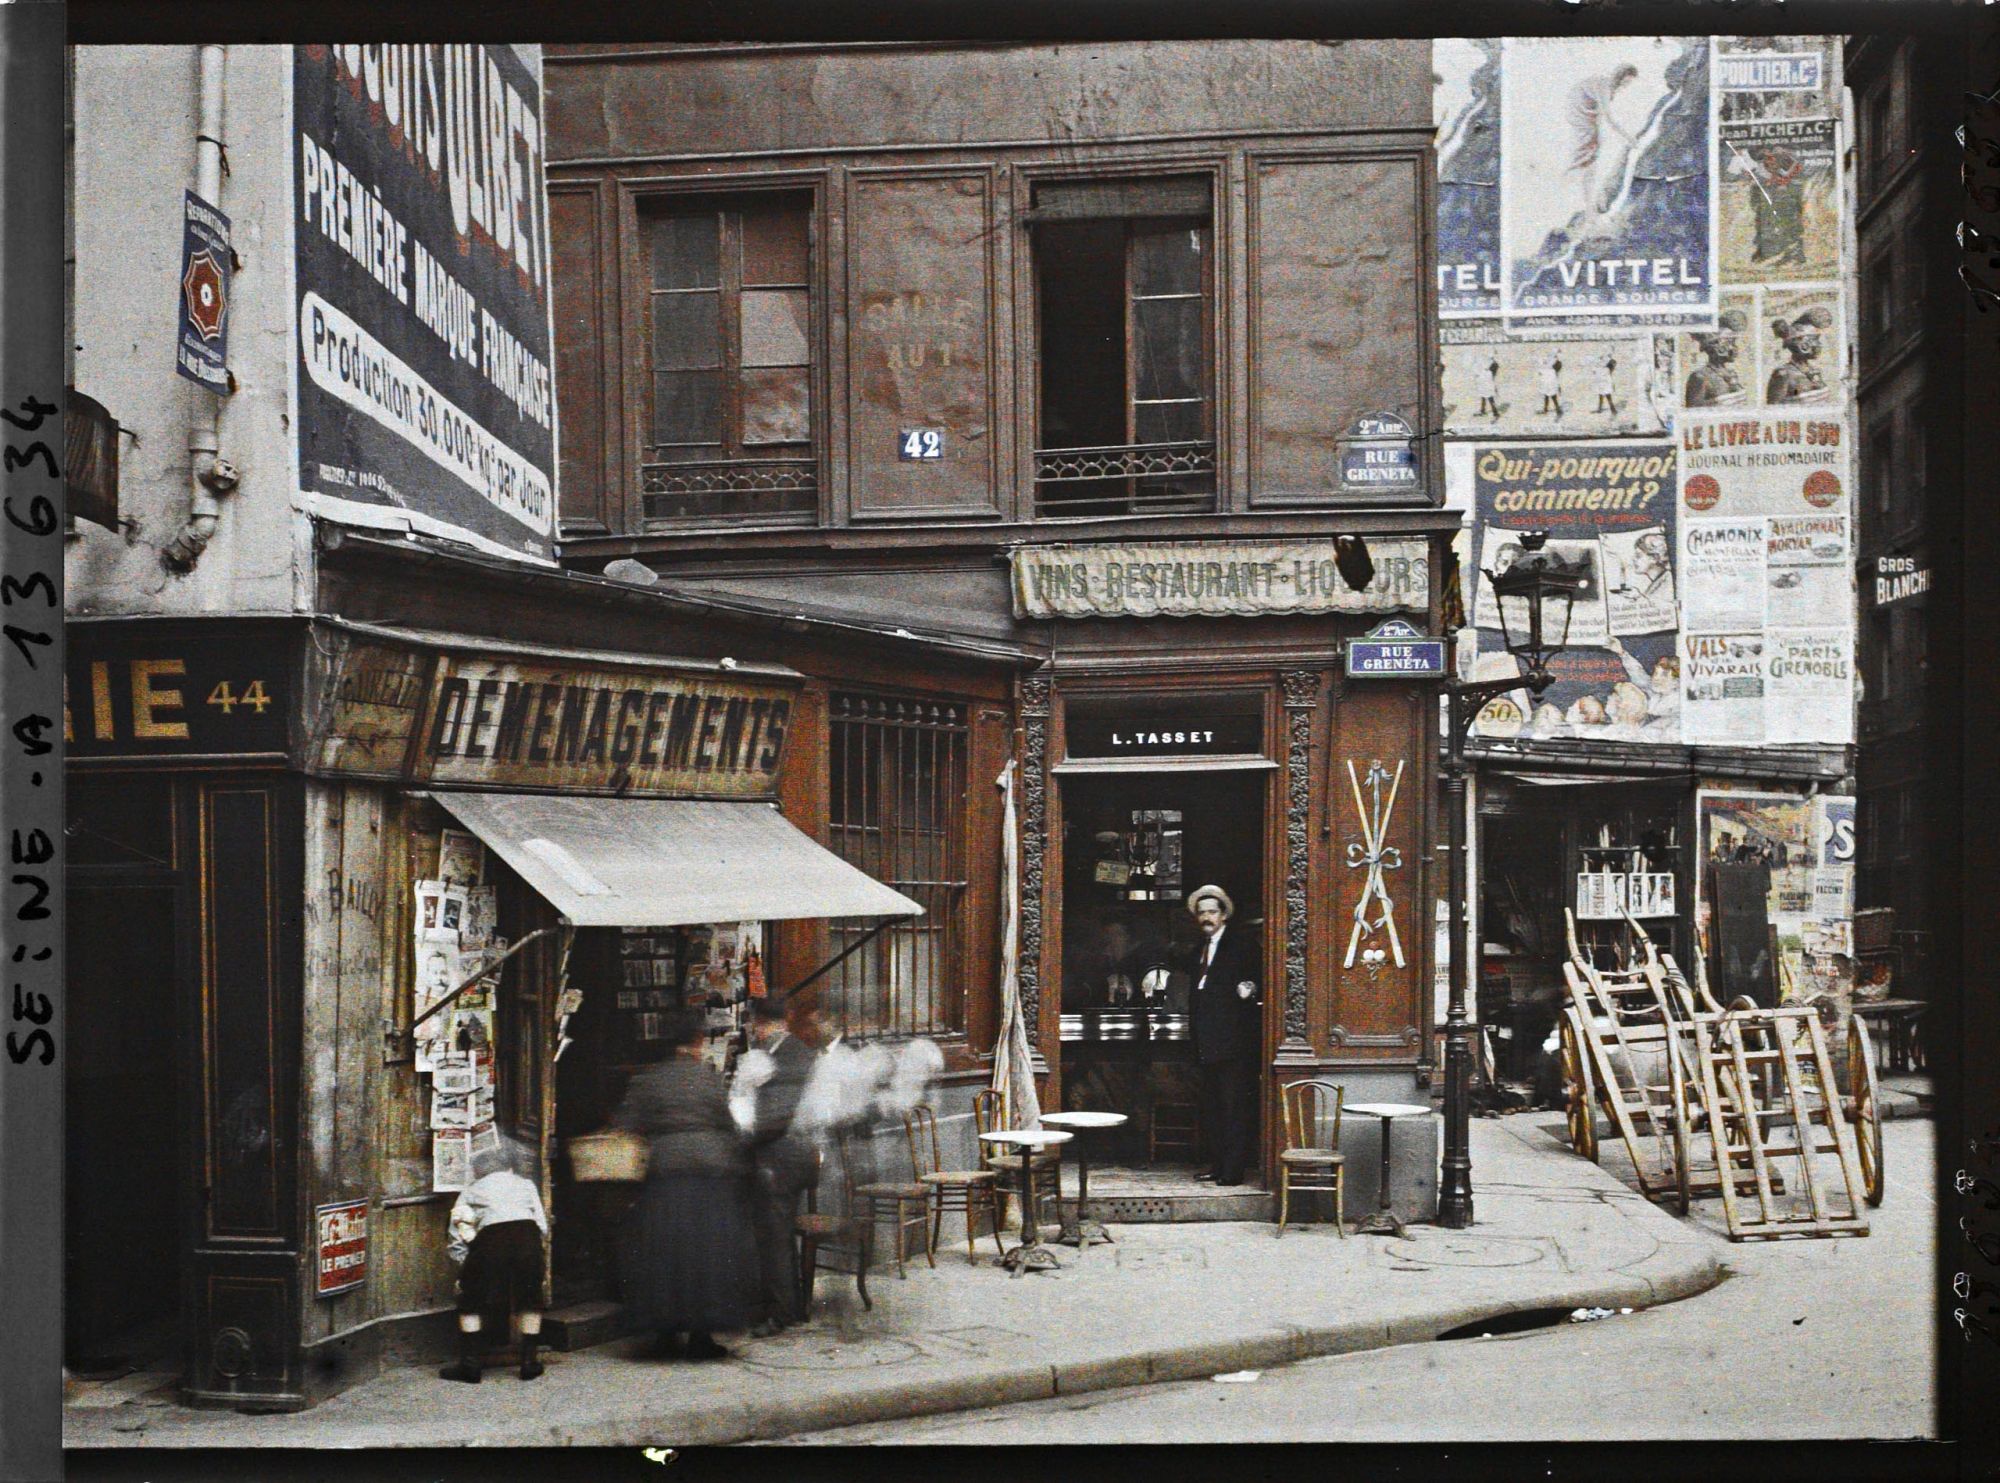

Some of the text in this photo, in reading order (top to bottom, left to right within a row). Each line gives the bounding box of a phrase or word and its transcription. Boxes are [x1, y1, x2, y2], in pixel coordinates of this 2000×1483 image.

[1750, 122, 1805, 138] FICHET
[1558, 258, 1702, 288] VITTEL
[1616, 290, 1699, 304] SOURCE
[415, 239, 477, 368] MARQUE
[481, 307, 551, 430] FRANÇAISE
[312, 304, 414, 428] Production
[497, 456, 517, 505] par
[904, 431, 941, 458] 42
[1683, 425, 1704, 451] LE
[1708, 420, 1760, 448] LIVRE
[1775, 420, 1801, 445] UN
[1805, 420, 1841, 447] SOU
[1365, 450, 1399, 464] RUE
[1686, 450, 1837, 469] JOURNAL HEBDOMADAIRE
[1686, 527, 1763, 557] CHAMONIX
[1878, 556, 1916, 573] GROS
[1028, 563, 1089, 601] VINS
[1107, 559, 1274, 600] RESTAURANT
[1381, 646, 1413, 658] RUE
[1686, 635, 1728, 660] VALS
[1788, 646, 1841, 659] PARIS
[1688, 662, 1762, 679] VIVARAIS
[1769, 656, 1848, 680] GRENOBLE
[206, 679, 273, 716] 44
[429, 676, 791, 775] DEMENAGEMENTS
[321, 1256, 333, 1274] LE
